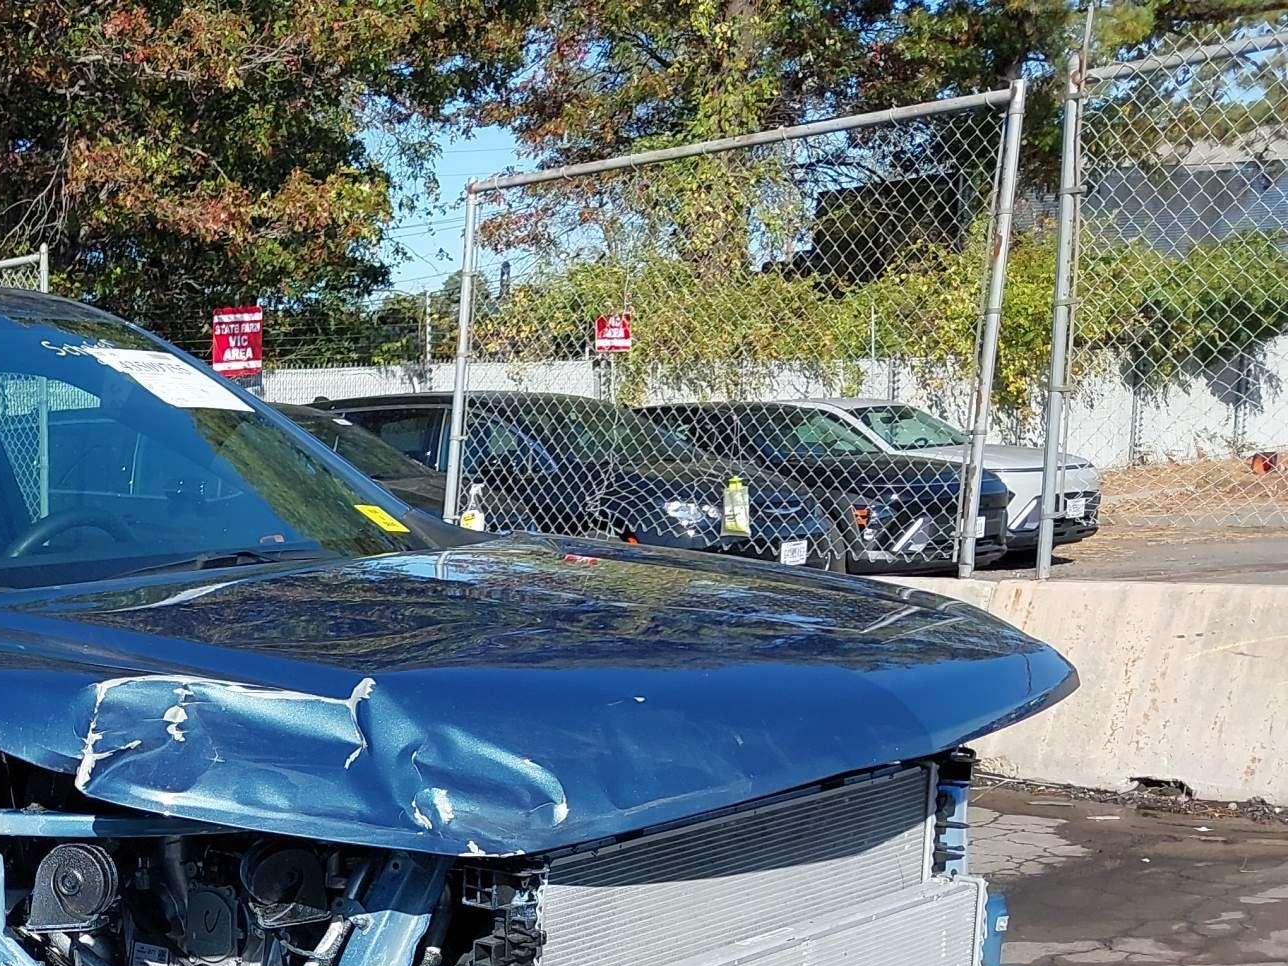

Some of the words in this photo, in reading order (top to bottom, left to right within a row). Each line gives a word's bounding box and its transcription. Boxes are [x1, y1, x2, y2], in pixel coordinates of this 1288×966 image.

[215, 323, 240, 335] STATE
[241, 322, 261, 333] FARM
[228, 335, 249, 347] VIC
[223, 347, 253, 361] AREA
